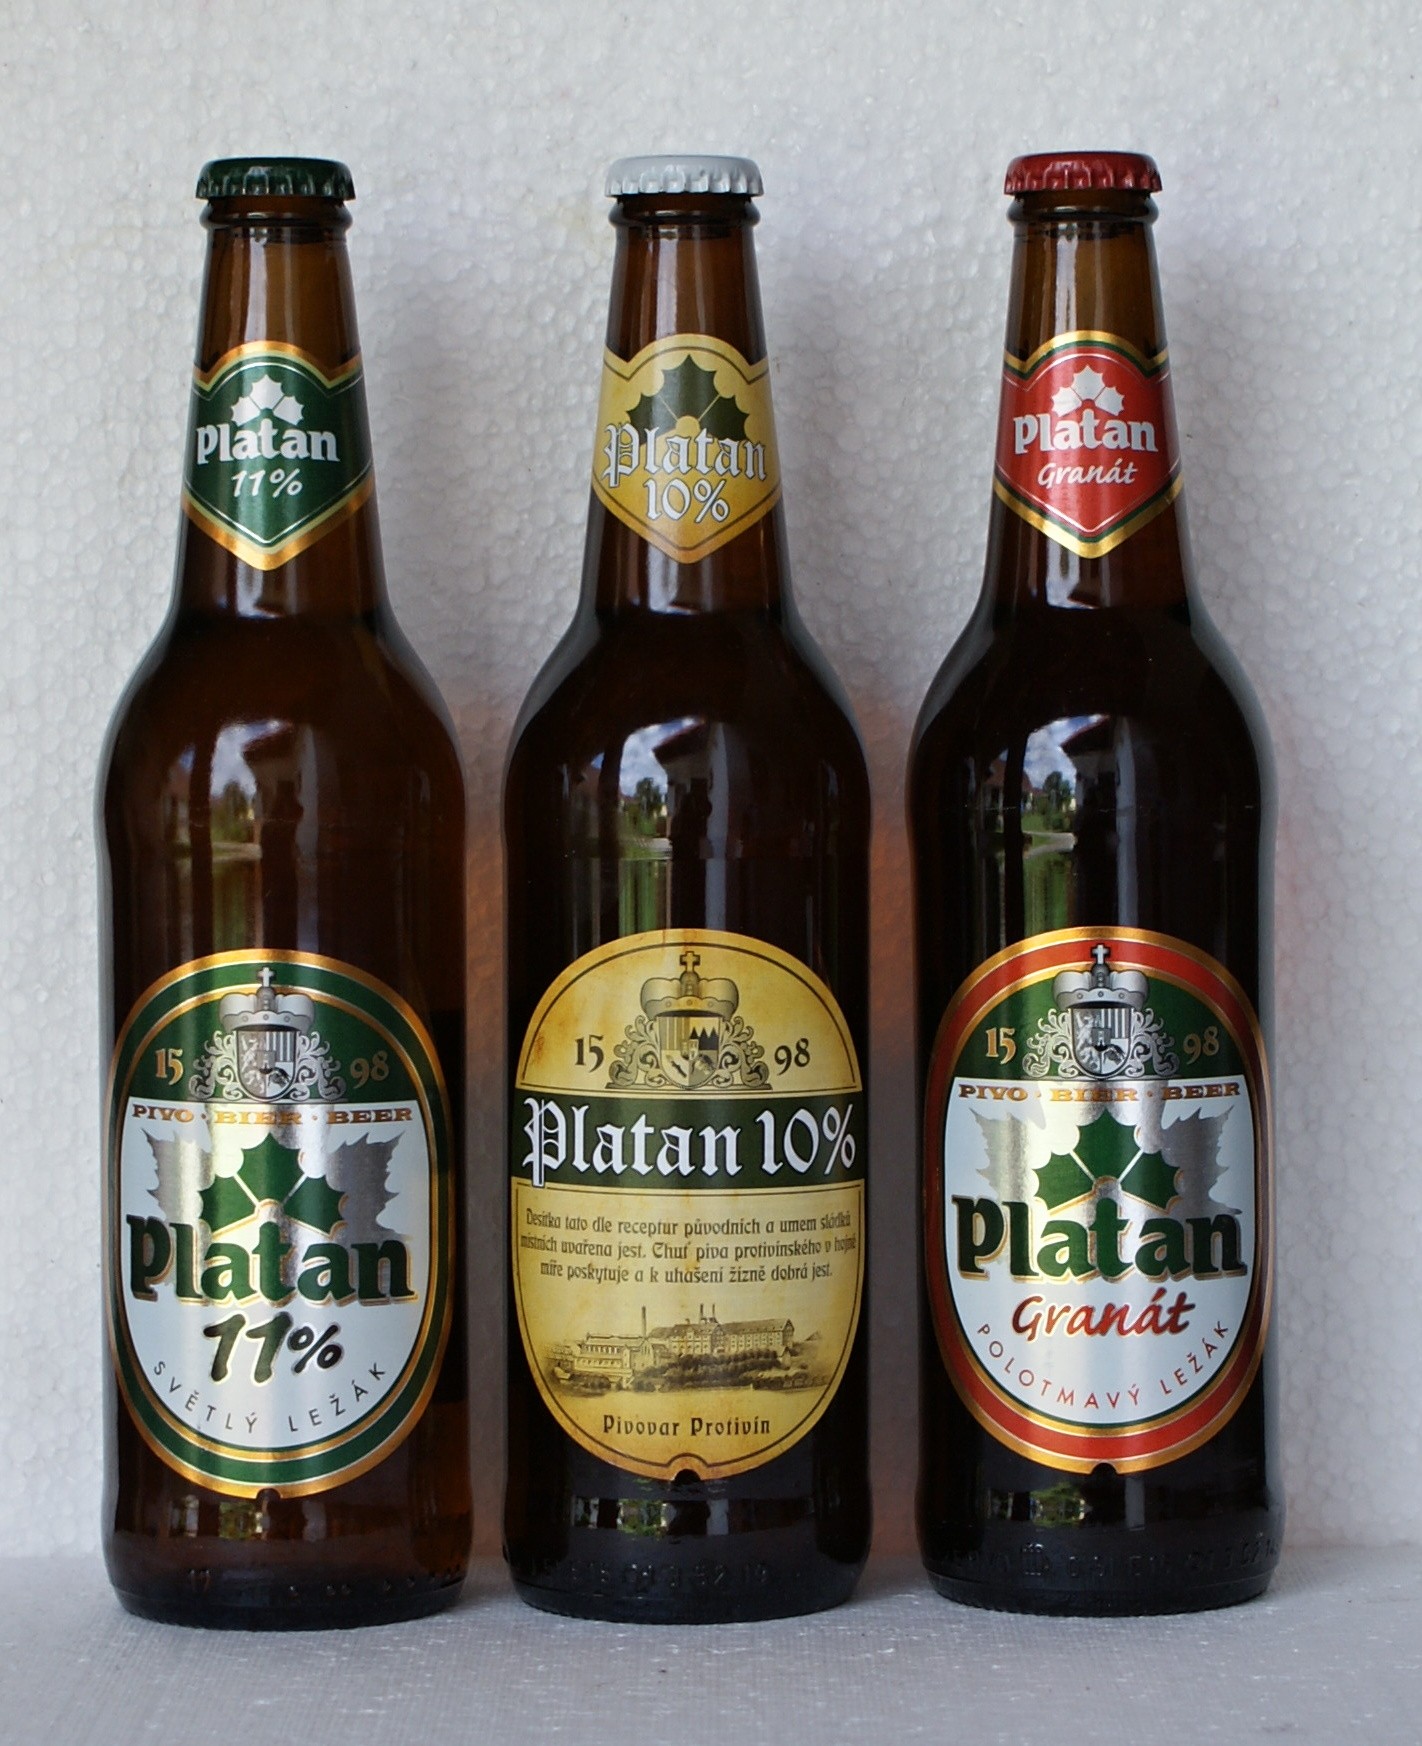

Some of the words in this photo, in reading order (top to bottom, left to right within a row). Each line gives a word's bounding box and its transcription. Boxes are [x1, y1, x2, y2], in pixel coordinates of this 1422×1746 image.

[196, 417, 341, 465] Platan
[1013, 408, 1159, 455] Platan
[602, 421, 767, 489] Platan
[1037, 457, 1139, 490] Granát
[231, 467, 304, 499] 11%
[643, 477, 731, 524] 10%
[574, 1034, 605, 1074] 15
[773, 1037, 812, 1076] 98
[985, 1027, 1017, 1065] 15
[1182, 1025, 1220, 1066] 98
[154, 1048, 185, 1086] 15
[350, 1050, 390, 1090] 98
[131, 1103, 196, 1123] PIVO
[213, 1109, 303, 1126] BIER
[325, 1106, 414, 1125] BEER
[957, 1083, 1029, 1102] PIVO
[1050, 1087, 1140, 1103] BIER
[1161, 1082, 1241, 1101] BEER
[522, 1096, 743, 1189] Platan
[755, 1103, 857, 1176] 10%
[565, 1215, 588, 1231] tato
[592, 1216, 613, 1233] dle
[618, 1219, 679, 1238] receptur
[684, 1218, 760, 1238] původních
[765, 1221, 775, 1234] a
[780, 1218, 817, 1233] umem
[951, 1194, 1248, 1284] Platan
[126, 1213, 419, 1307] Platan
[561, 1238, 612, 1257] uvařena
[617, 1240, 647, 1260] jest.
[651, 1241, 692, 1259] Chuť
[696, 1242, 729, 1262] piva
[734, 1239, 822, 1262] protivínského
[567, 1262, 629, 1285] poskytuje
[634, 1270, 644, 1282] a
[650, 1266, 659, 1283] k
[665, 1266, 723, 1284] uhašení
[728, 1265, 766, 1283] žízně
[770, 1262, 808, 1282] dobrá
[811, 1261, 833, 1281] jest.
[1011, 1286, 1196, 1343] Granát
[203, 1310, 345, 1387] 11%
[977, 1322, 1141, 1410] POLOTMAVÝ
[1159, 1320, 1229, 1395] LEŽÁK
[153, 1361, 258, 1434] SVĚTLÝ
[287, 1362, 386, 1433] LEŽÁK
[603, 1414, 680, 1437] Pivovar
[690, 1415, 771, 1436] Protivín
